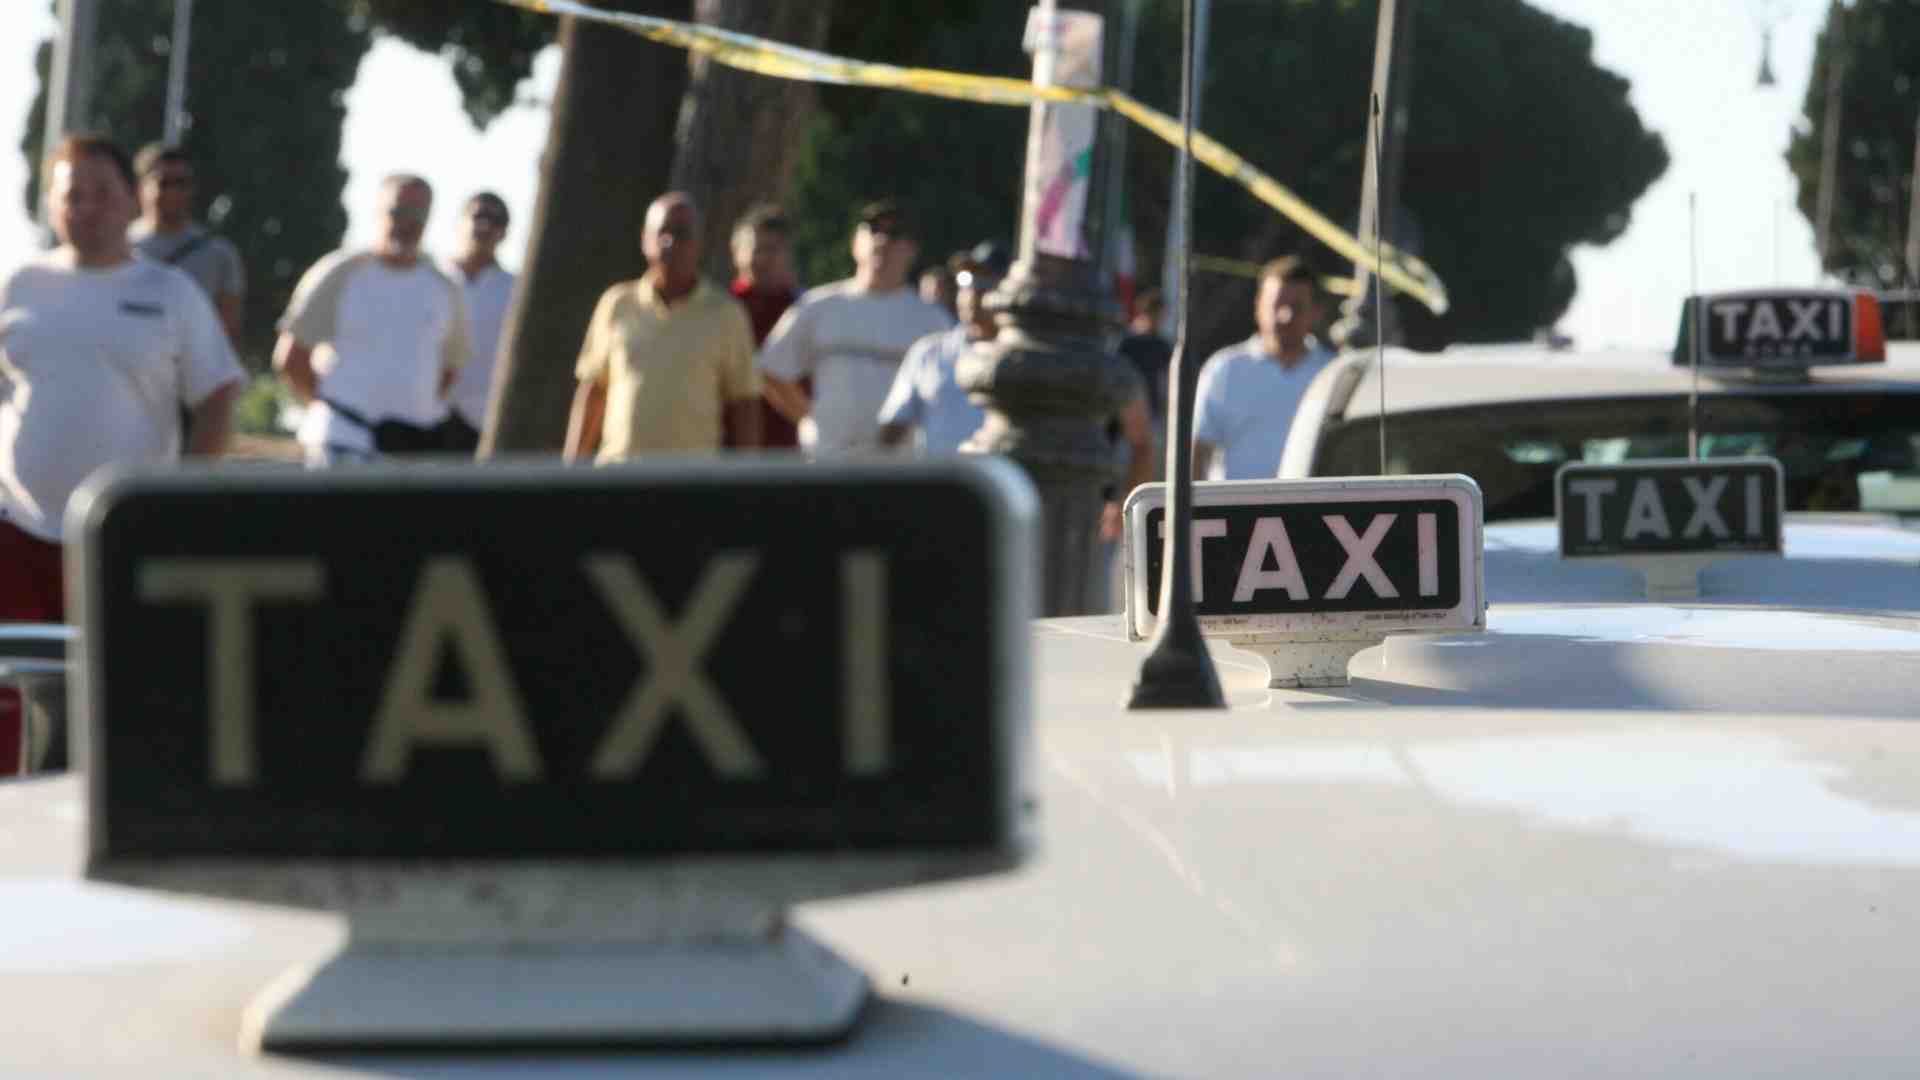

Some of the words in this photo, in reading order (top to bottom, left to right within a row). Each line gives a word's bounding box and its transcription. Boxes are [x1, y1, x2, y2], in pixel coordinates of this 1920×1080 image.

[1712, 302, 1843, 341] TAXI
[1568, 474, 1763, 542] TAXI
[1157, 512, 1440, 603] TAXI
[137, 549, 891, 786] TAXI
